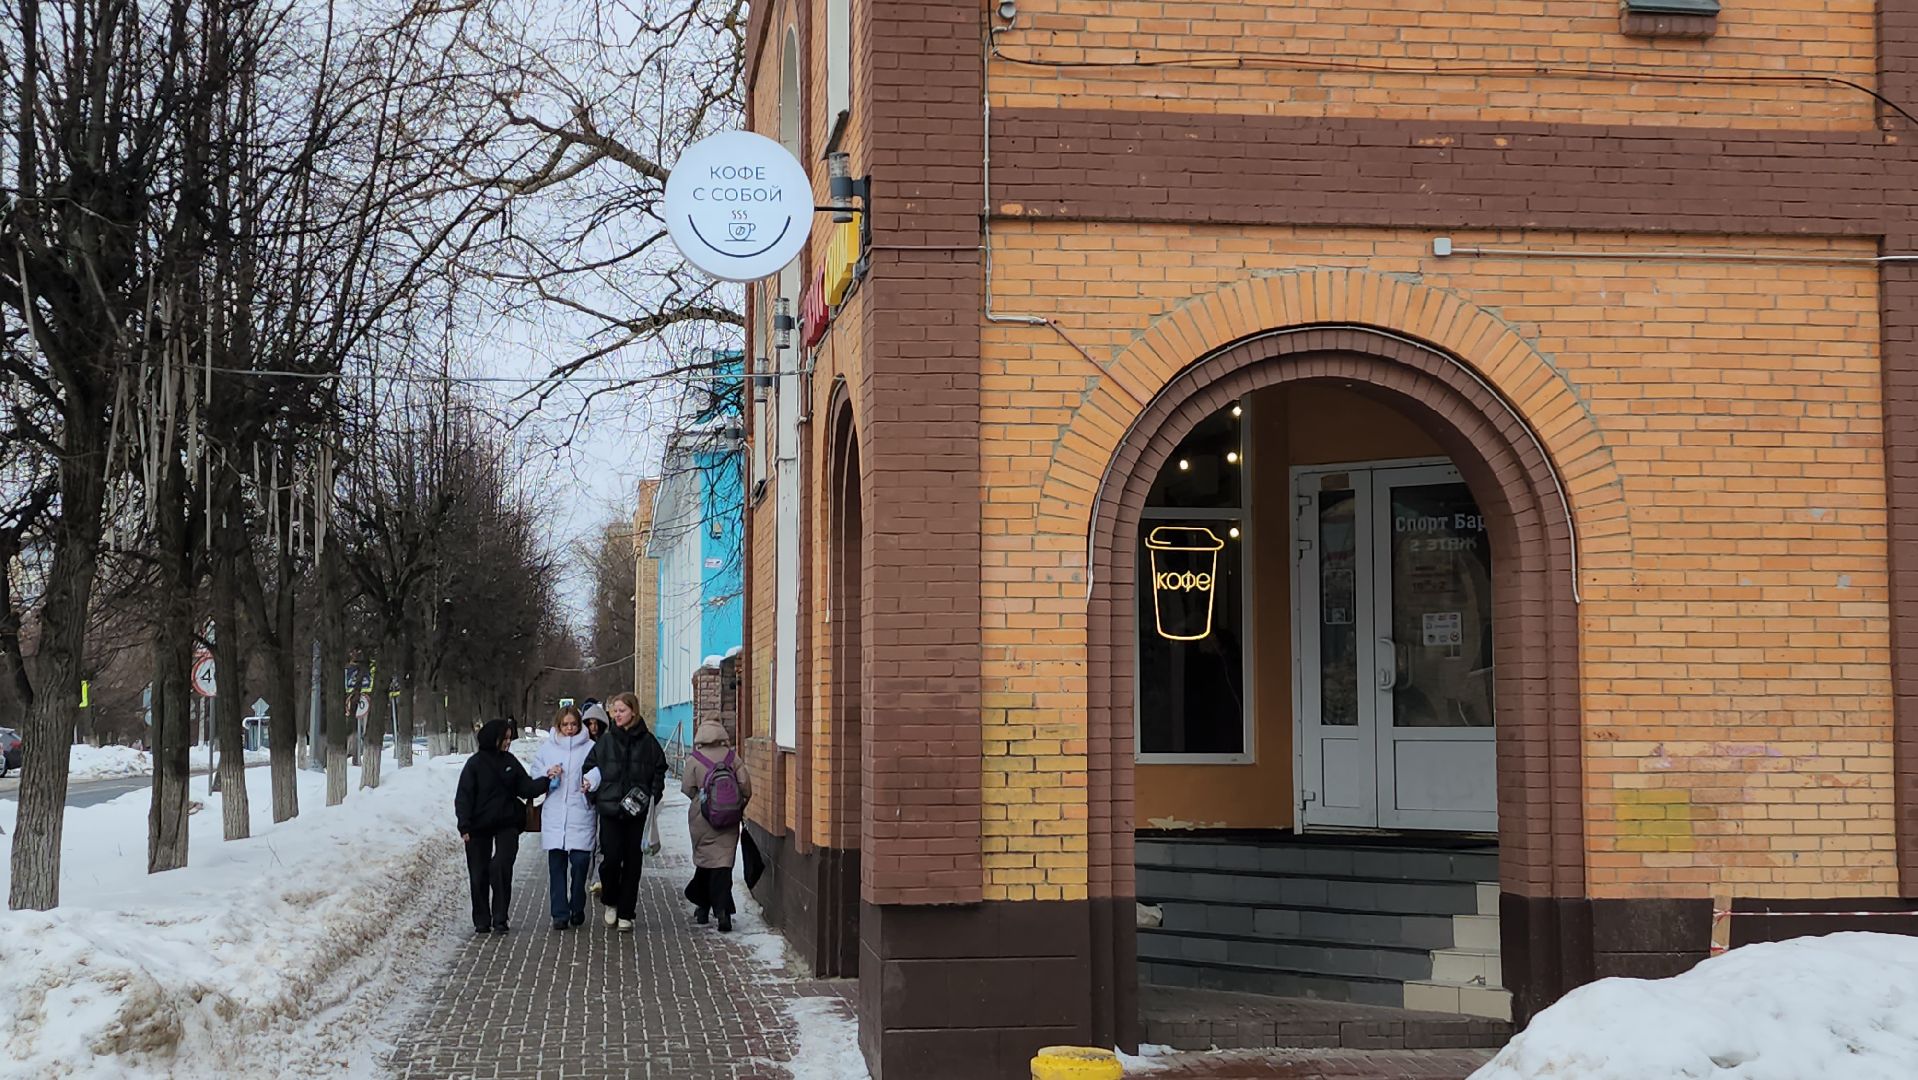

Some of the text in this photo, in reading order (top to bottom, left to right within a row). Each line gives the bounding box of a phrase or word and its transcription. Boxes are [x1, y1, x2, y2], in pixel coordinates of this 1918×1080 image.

[710, 166, 766, 180] КОФЕ
[692, 185, 782, 202] С СОБОЙ
[1395, 513, 1486, 534] Спорт Бар
[1157, 570, 1212, 593] кофе
